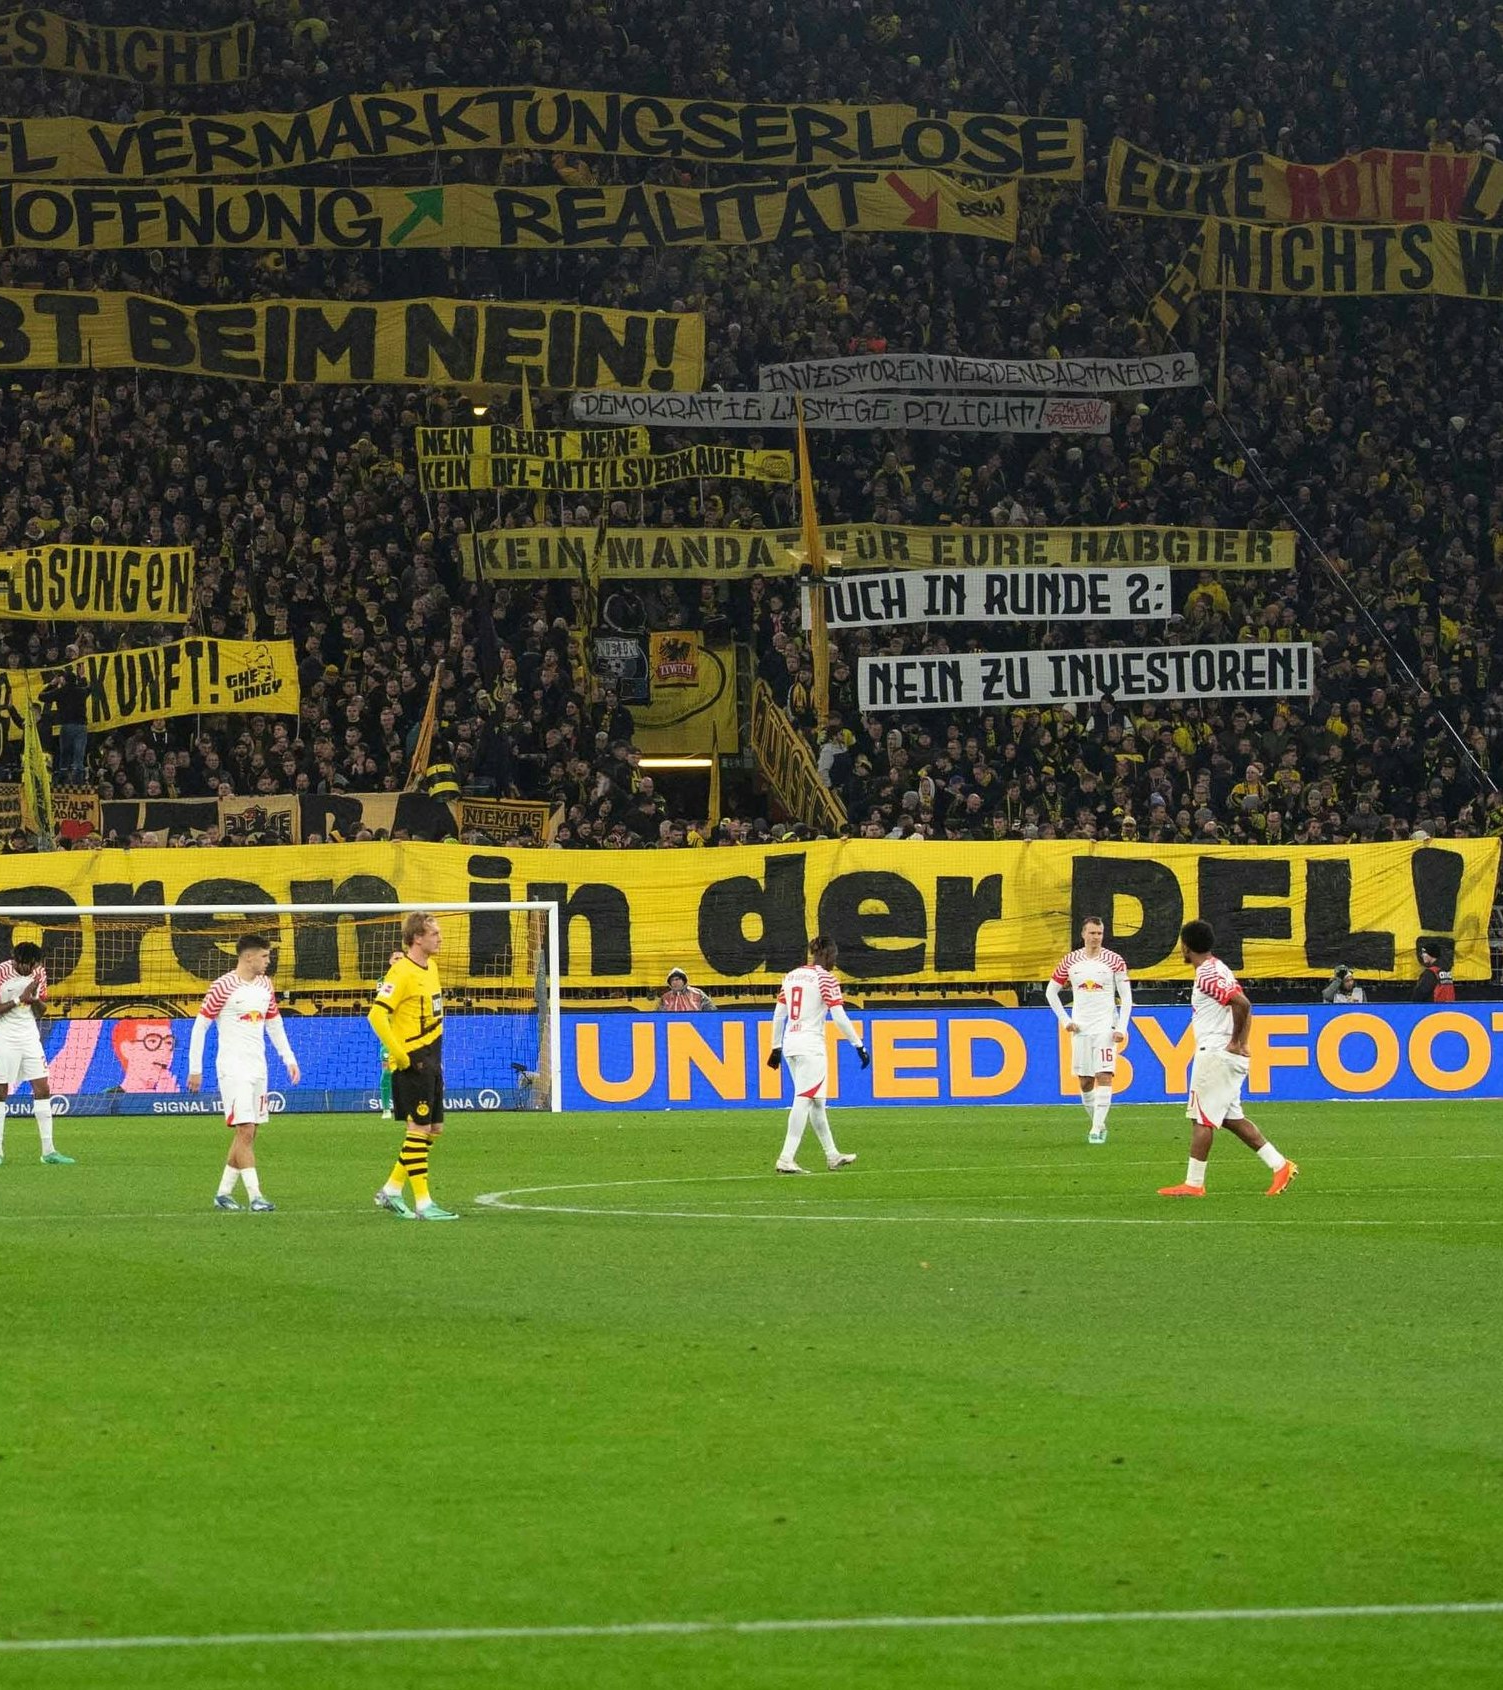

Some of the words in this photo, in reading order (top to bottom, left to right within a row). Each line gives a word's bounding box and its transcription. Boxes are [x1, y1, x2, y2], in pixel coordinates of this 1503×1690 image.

[67, 22, 251, 84] NICHT!
[90, 89, 1075, 175] VERMARKTUNGSERLÖSE
[1118, 153, 1267, 218] EURE
[1284, 148, 1470, 221] ROTEN
[1217, 222, 1435, 292] NICHTS
[127, 296, 378, 384] BEIM
[404, 302, 680, 392] NEIN!
[763, 359, 935, 392] INVESTOREN
[580, 393, 762, 419] DEMOKRATIE
[422, 428, 474, 456] NEIN
[491, 425, 566, 457] BLEIBT
[421, 458, 471, 488] KEIN
[478, 536, 586, 571] KEIN
[608, 533, 801, 570] MANDAT
[931, 533, 1049, 567] EURE
[1070, 529, 1274, 564] HABGIER
[924, 573, 967, 616] IN
[984, 572, 1113, 617] RUNDE
[38, 639, 222, 728] KUNFT!
[868, 661, 964, 706] NEIN
[980, 656, 1031, 701] ZU
[1049, 647, 1310, 700] INVESTOREN!
[463, 806, 544, 830] NIEMALS
[467, 854, 632, 977] in
[697, 852, 1003, 979] der
[1071, 847, 1465, 971] DFL!
[791, 986, 803, 1021] 8
[575, 1017, 1028, 1102] UNITED
[1248, 1010, 1503, 1093] FOO
[1100, 1048, 1114, 1063] 16
[153, 1101, 211, 1114] SIGNAL
